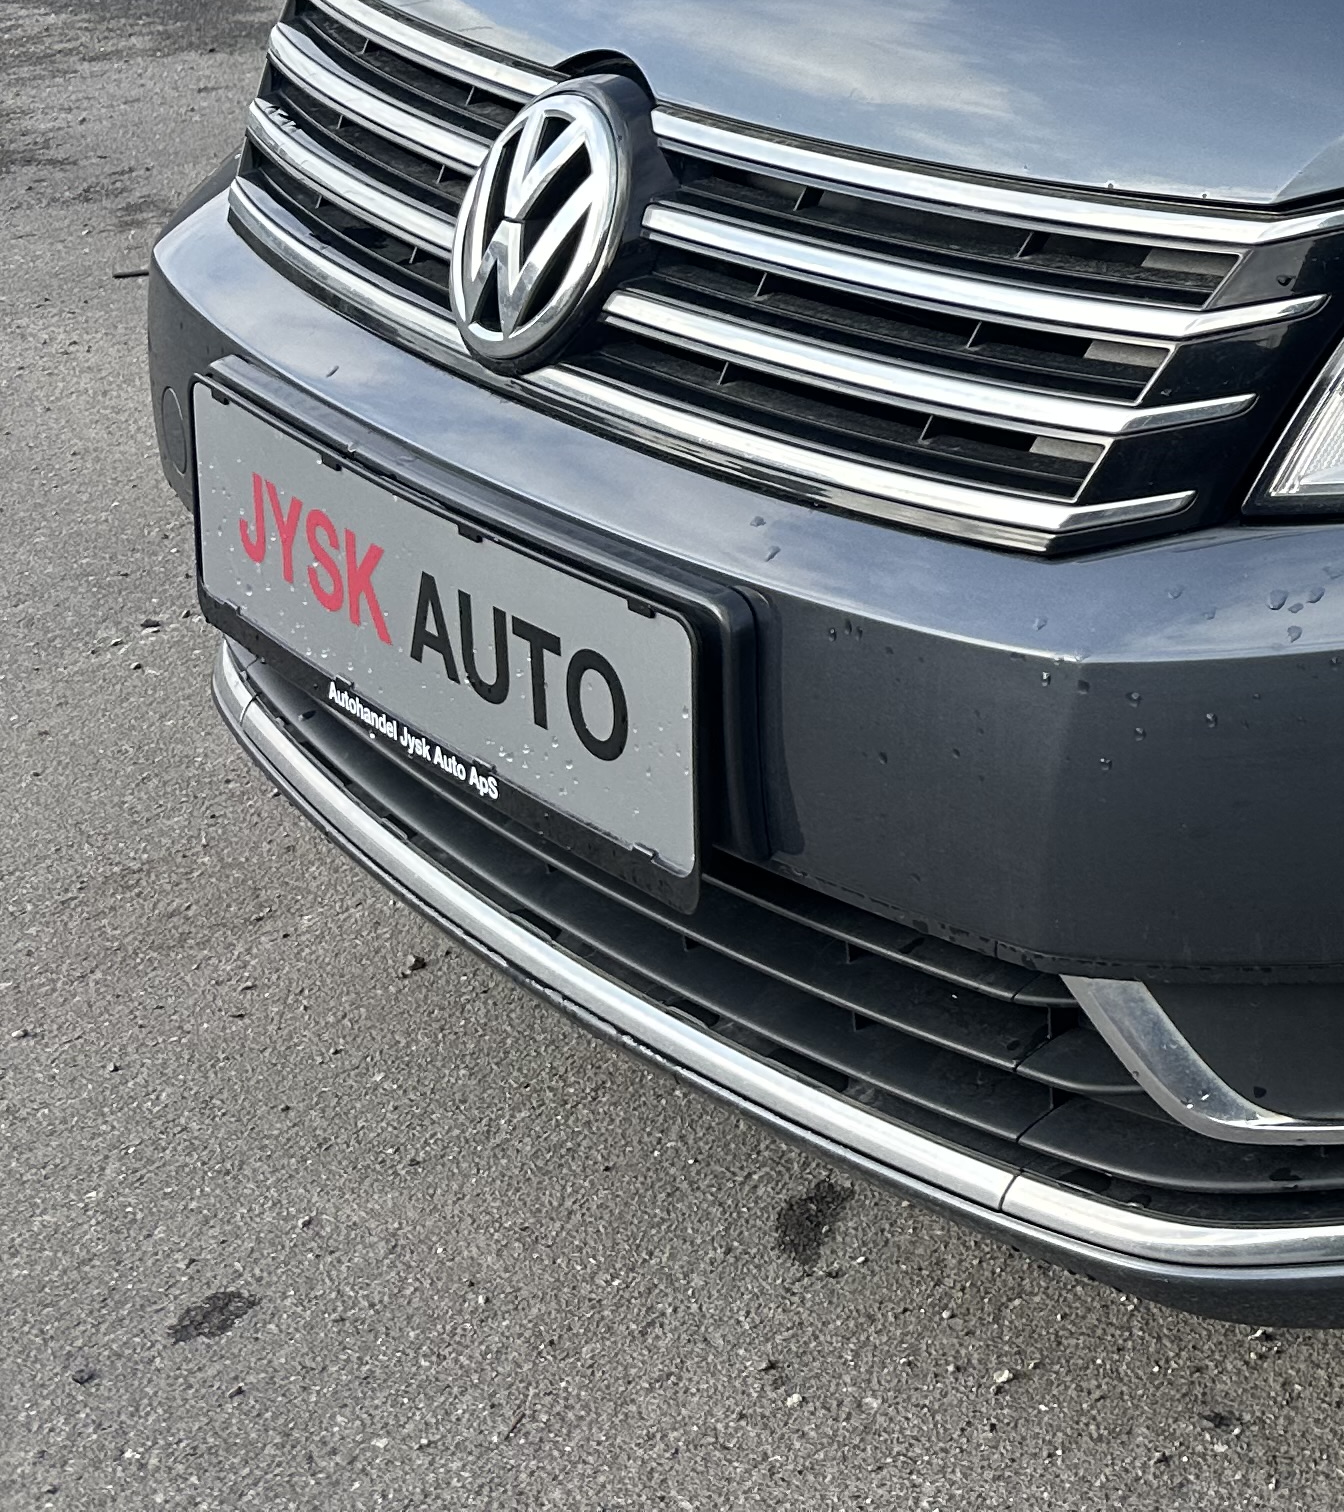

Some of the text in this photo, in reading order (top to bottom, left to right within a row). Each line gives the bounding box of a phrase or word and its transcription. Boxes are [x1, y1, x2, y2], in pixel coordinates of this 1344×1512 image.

[450, 93, 622, 360] VW
[239, 472, 629, 762] JYSK AUTO
[328, 680, 499, 800] Autohandel Jysk Auto ApS
